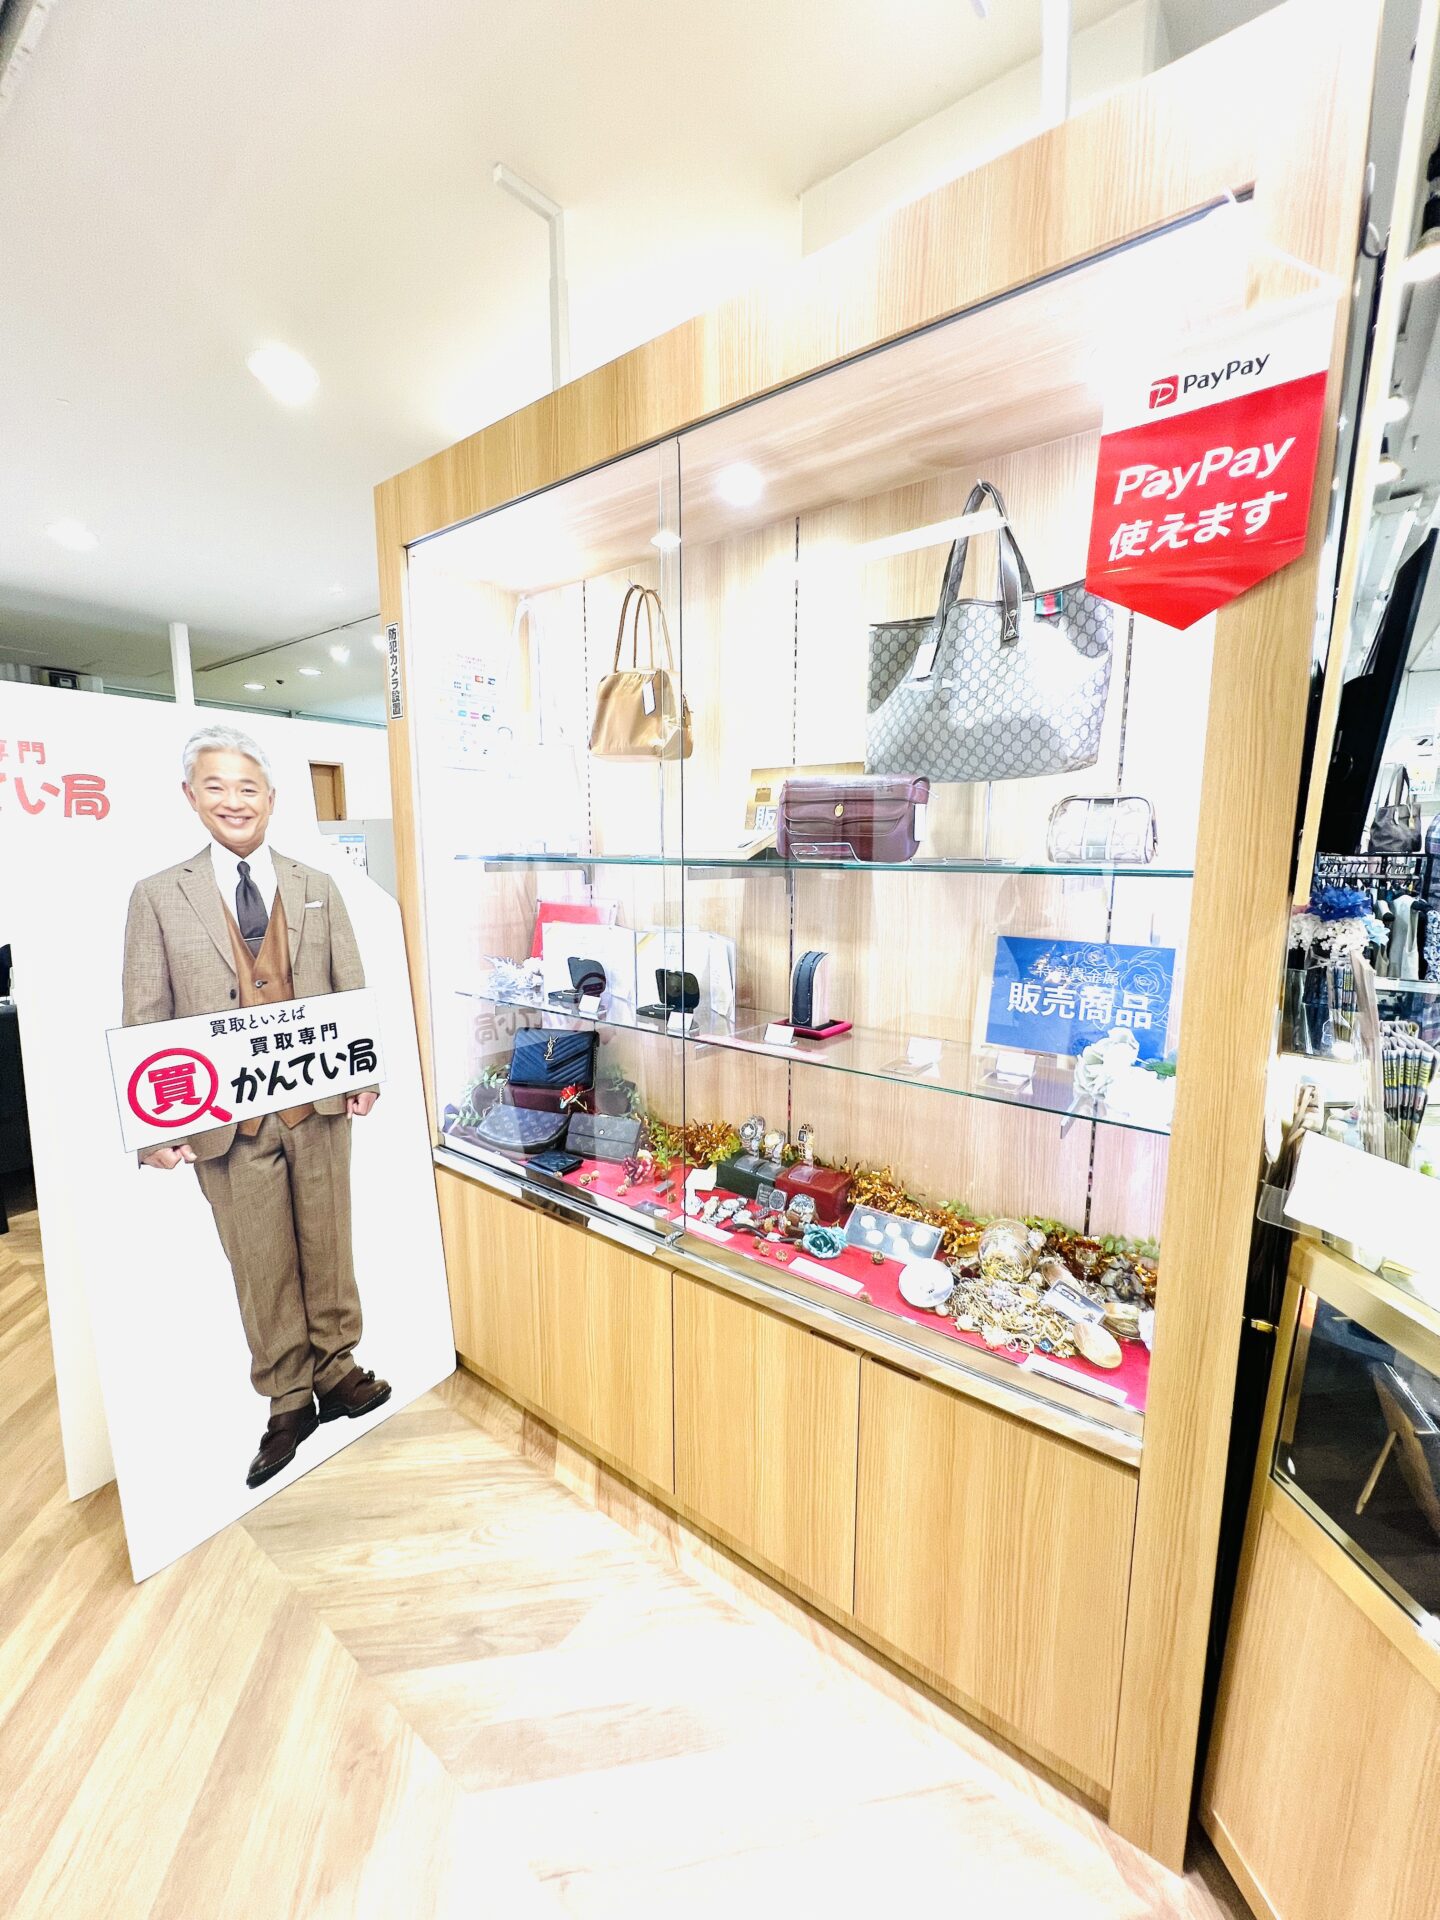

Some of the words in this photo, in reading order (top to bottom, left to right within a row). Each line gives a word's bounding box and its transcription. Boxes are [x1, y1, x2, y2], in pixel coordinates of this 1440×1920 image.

[1184, 353, 1270, 394] PayPay
[1113, 436, 1297, 505] PayPay
[1108, 490, 1288, 562] 使えます
[388, 627, 401, 715] 防犯カメラ設置
[0, 772, 110, 820] い局
[210, 1005, 306, 1037] 買取といえば
[1007, 982, 1153, 1030] 販売商品
[250, 1022, 338, 1056] 買取専門
[148, 1062, 202, 1115] 買
[231, 1038, 377, 1103] かんてい局
